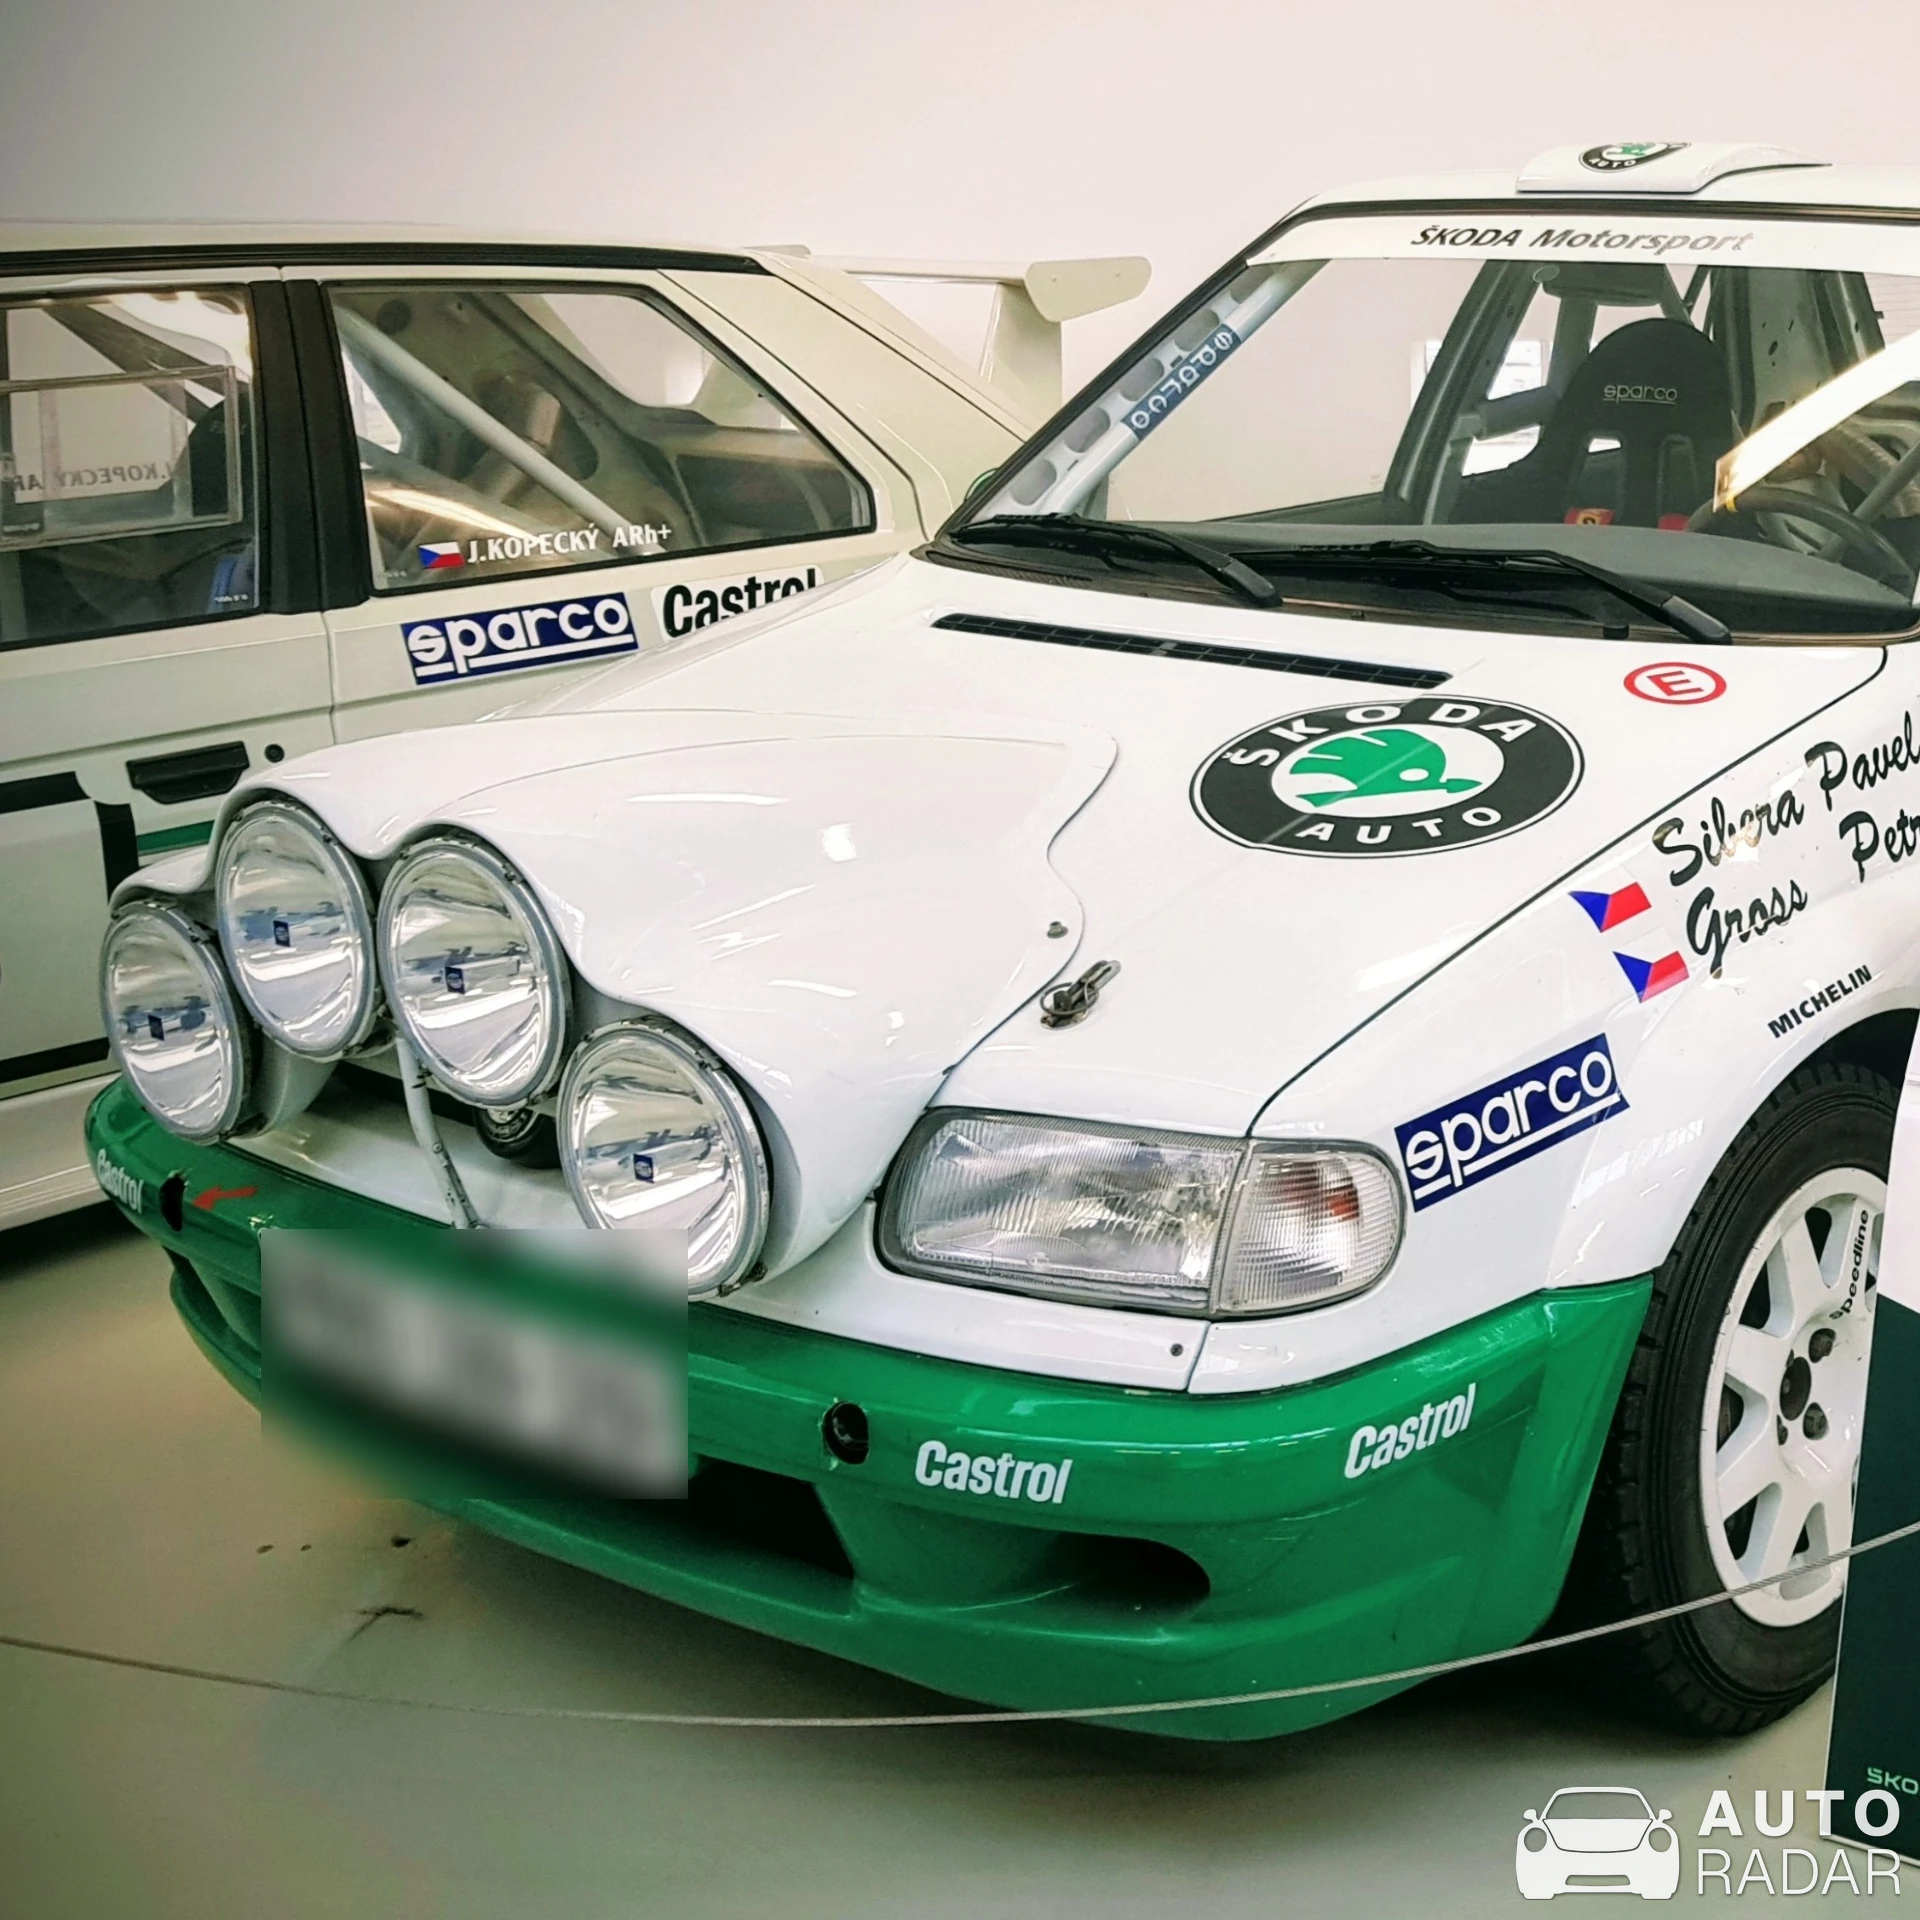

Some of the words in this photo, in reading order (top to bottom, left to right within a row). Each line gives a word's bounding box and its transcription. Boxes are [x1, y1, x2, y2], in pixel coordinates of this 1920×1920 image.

[1588, 158, 1637, 168] AUTO
[1410, 225, 1524, 248] ŠKODA
[1528, 228, 1754, 256] Motorsport
[1130, 331, 1234, 430] sparco
[1603, 384, 1678, 404] sparco
[467, 523, 600, 563] J.KOPECKÝ
[612, 523, 673, 548] ARh+
[407, 598, 629, 674] sparco
[1646, 670, 1705, 696] E
[1221, 703, 1537, 767] ŠKODA
[1804, 710, 1920, 811] Pavel
[1295, 807, 1502, 845] AUTO
[1686, 880, 1807, 979] Gross
[1767, 965, 1872, 1039] MICHELIN
[1406, 1051, 1612, 1188] sparco
[1829, 1210, 1868, 1319] speedline
[1344, 1382, 1477, 1479] Castrol
[915, 1440, 1073, 1504] Castrol
